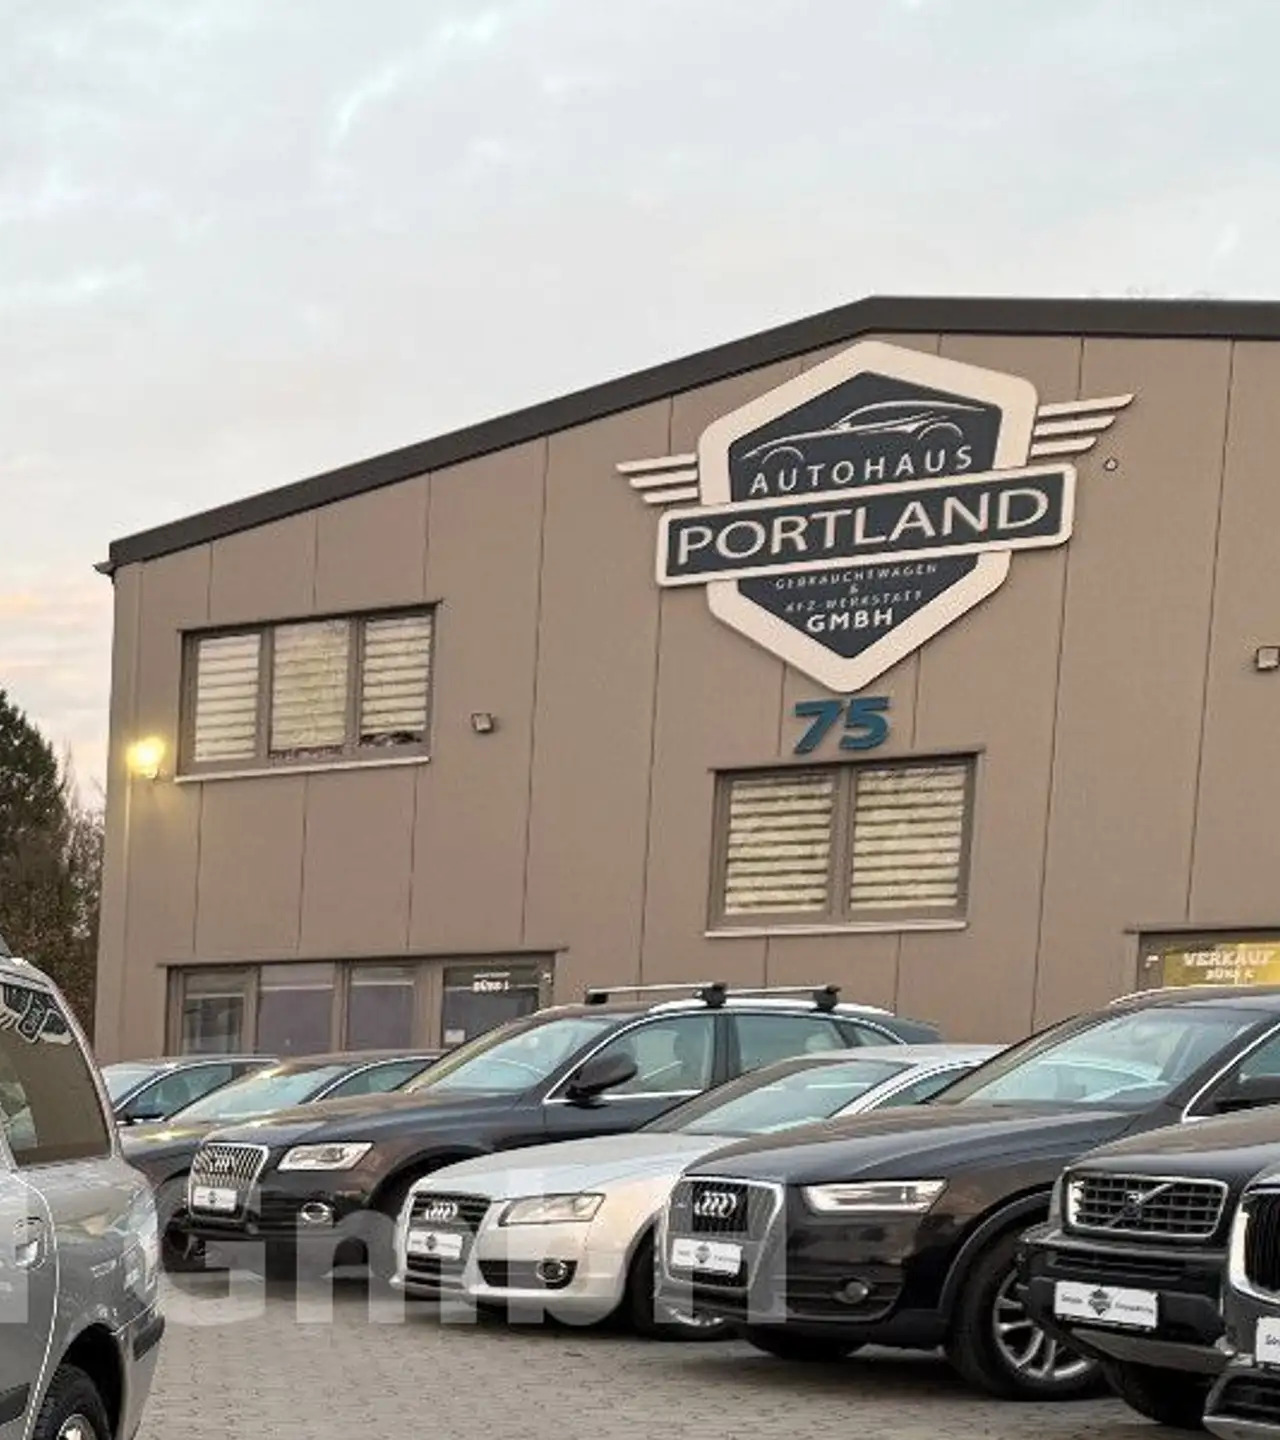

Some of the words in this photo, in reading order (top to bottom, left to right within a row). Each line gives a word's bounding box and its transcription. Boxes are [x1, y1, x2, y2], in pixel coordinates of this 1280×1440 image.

[749, 444, 974, 496] AUTOHAUS
[677, 486, 1049, 566] PORTLAND
[775, 563, 938, 590] GEBRAUCHTWAGEN
[806, 608, 894, 632] GMBH
[792, 696, 890, 754] 75
